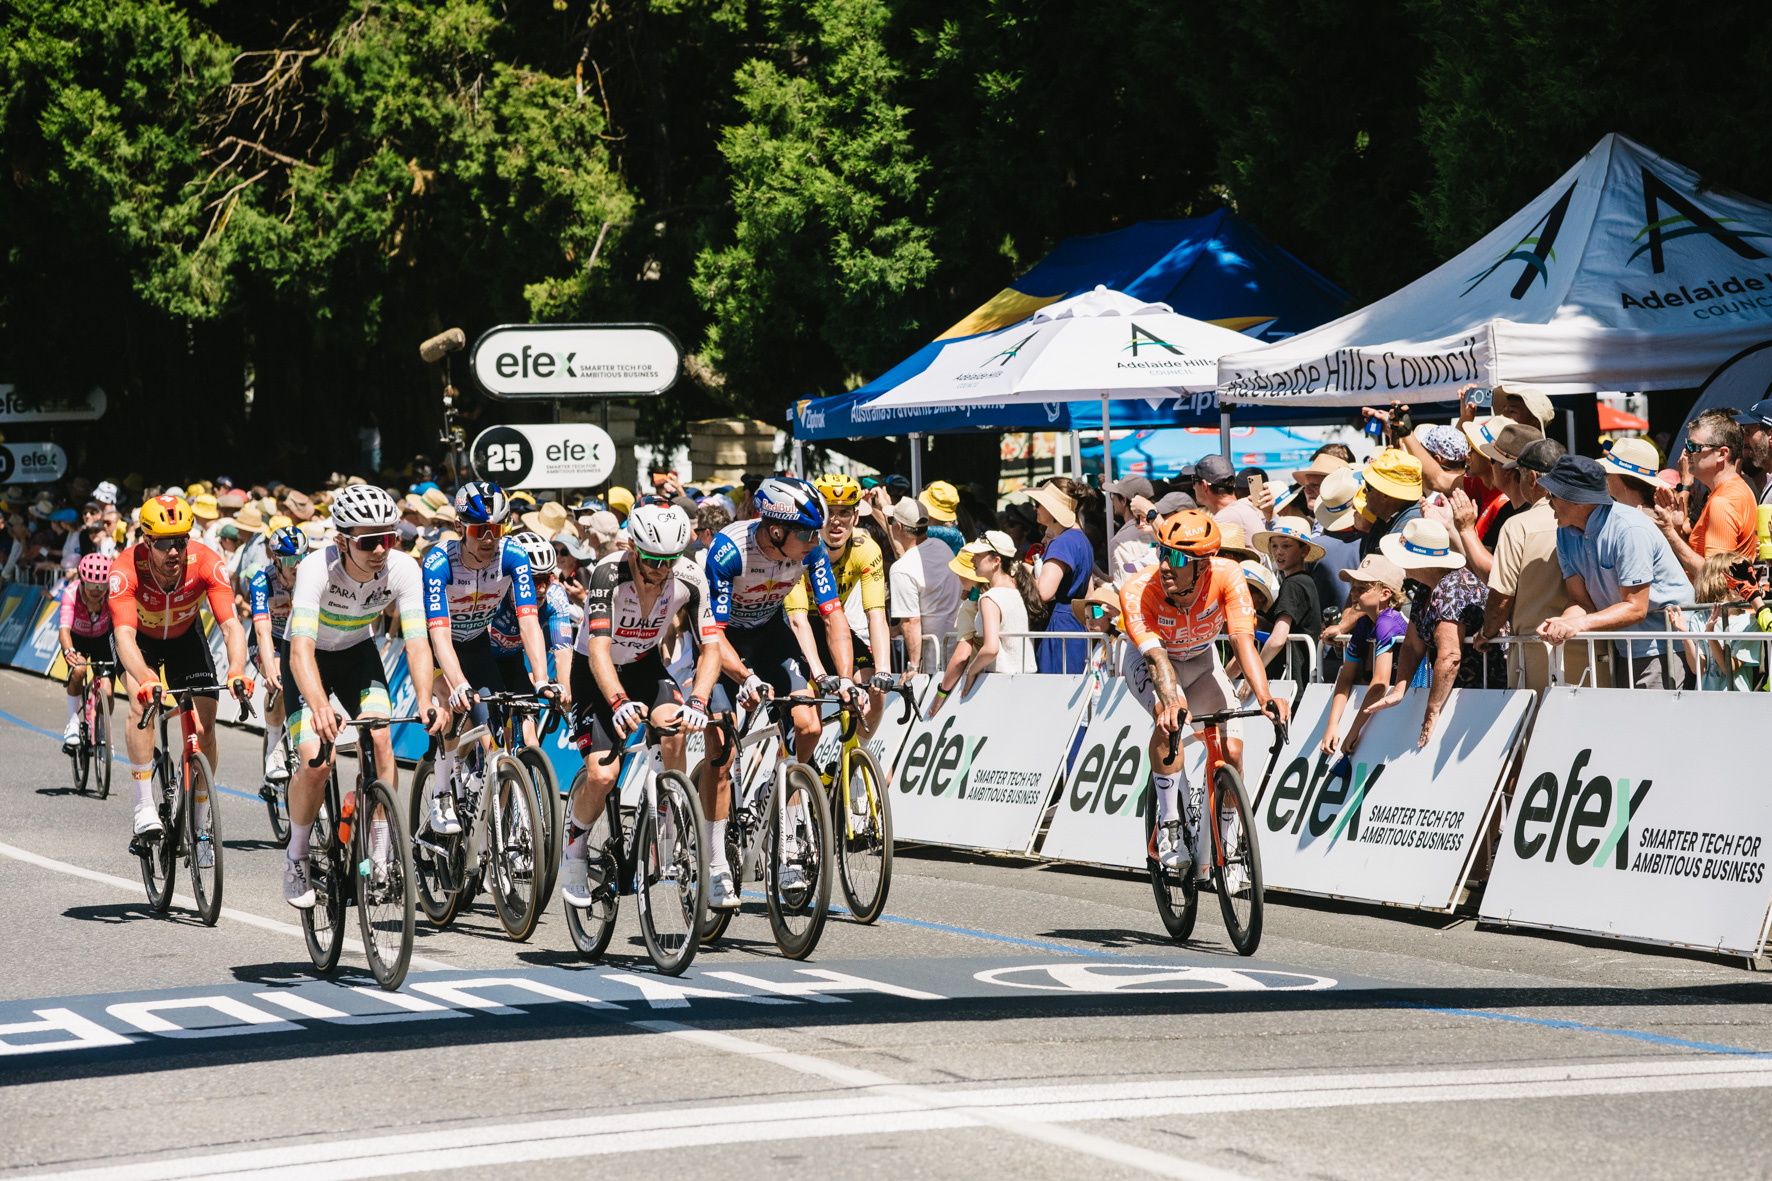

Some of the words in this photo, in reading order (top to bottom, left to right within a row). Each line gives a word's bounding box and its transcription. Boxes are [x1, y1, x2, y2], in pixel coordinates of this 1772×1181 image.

[1621, 276, 1766, 309] Adelaide
[495, 345, 577, 378] efex
[1117, 359, 1182, 369] Adelaide
[1185, 358, 1217, 367] Hills
[1325, 349, 1376, 392] Hills
[1383, 337, 1480, 389] Council
[487, 443, 522, 472] 25
[546, 439, 600, 461] efex
[424, 551, 443, 569] BORA
[714, 541, 734, 563] BORA
[515, 564, 531, 599] BOSS
[814, 557, 832, 594] BOSS
[430, 578, 441, 611] BOSS
[620, 628, 656, 639] Emirates
[185, 671, 214, 681] FUSION
[900, 715, 988, 799] efex
[974, 769, 1008, 785] SMARTER
[1007, 771, 1028, 786] TECH
[1025, 772, 1042, 787] FOR
[966, 786, 1007, 803] AMBITIOUS
[1006, 789, 1041, 805] BUSINESS
[1266, 752, 1386, 841] efex
[1513, 748, 1653, 871] efex
[1369, 805, 1416, 826] SMARTER
[1415, 808, 1445, 828] TECH
[1441, 811, 1465, 829] FOR
[1359, 826, 1416, 848] AMBITIOUS
[1415, 830, 1464, 851] BUSINESS
[1639, 827, 1699, 852] SMARTER
[1700, 832, 1735, 855] TECH
[1734, 835, 1762, 858] FOR
[1631, 852, 1702, 878] AMBITIOUS
[1702, 858, 1765, 884] BUSINESS
[0, 968, 949, 1056] HYUNDA
